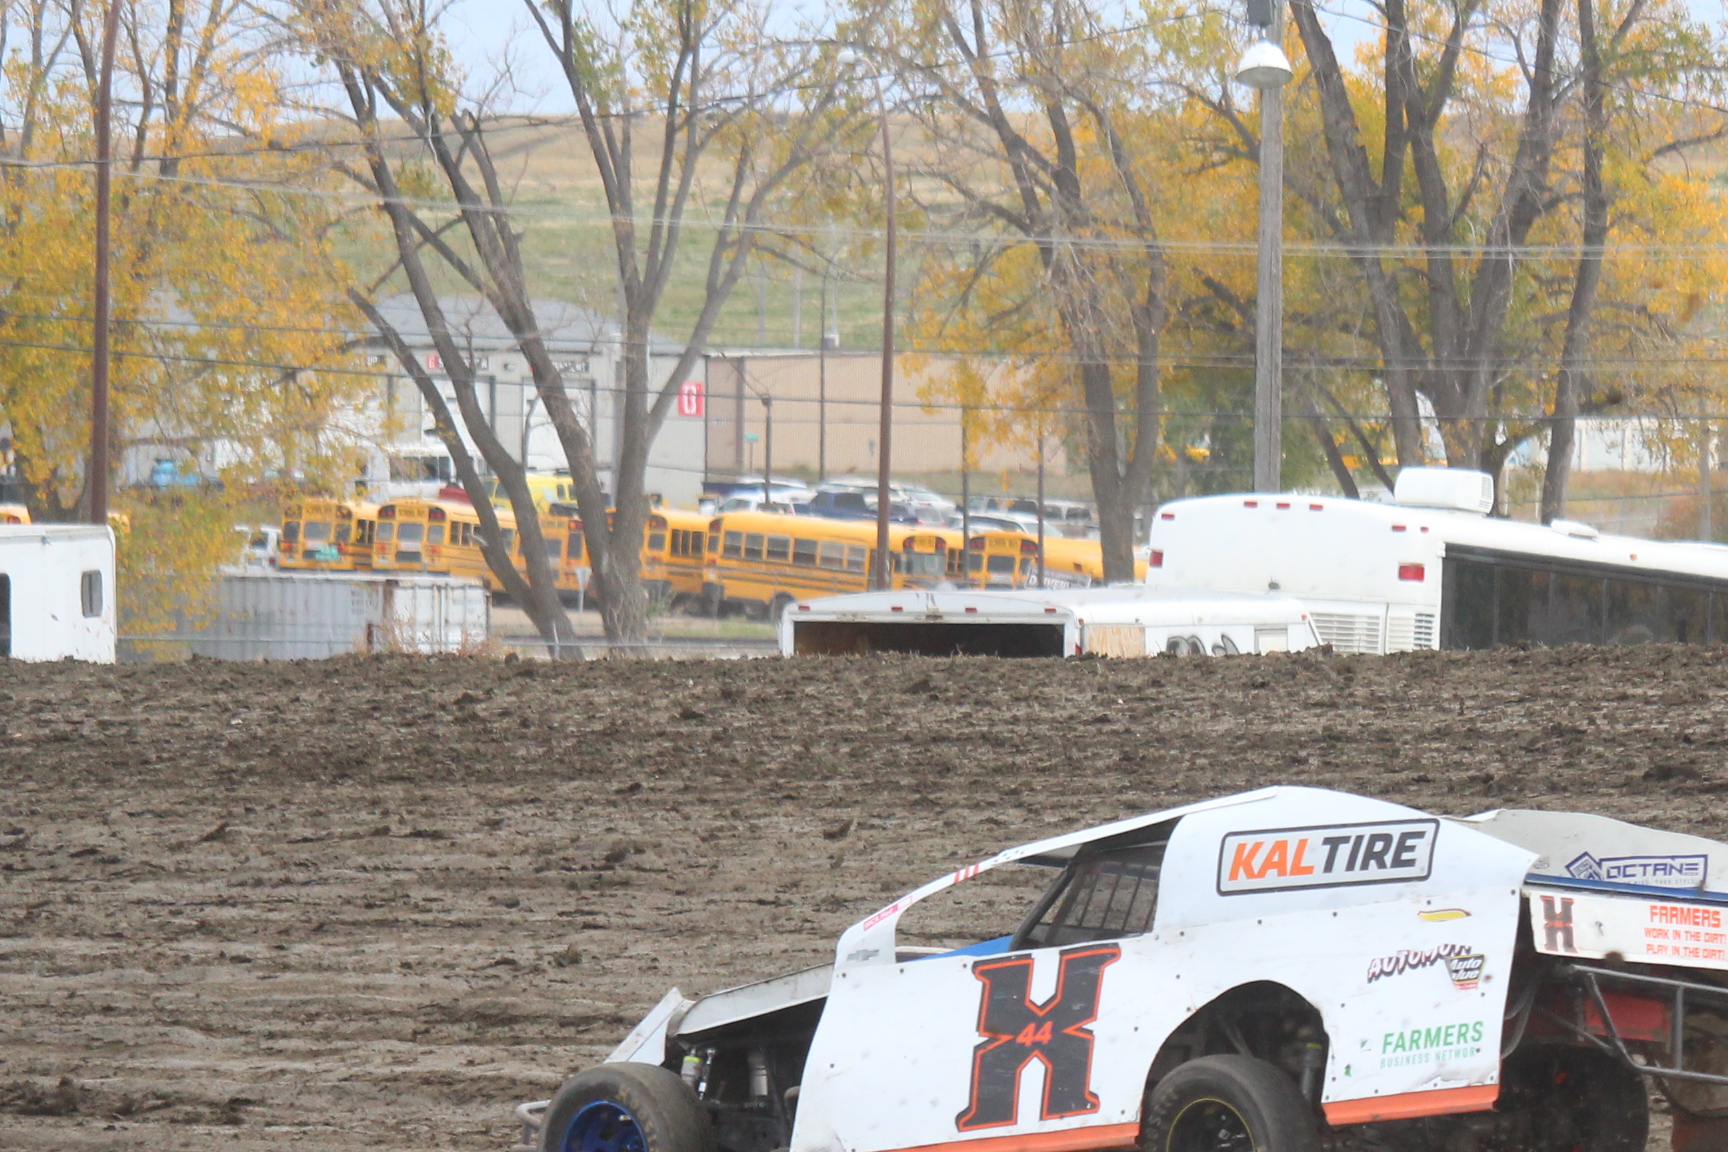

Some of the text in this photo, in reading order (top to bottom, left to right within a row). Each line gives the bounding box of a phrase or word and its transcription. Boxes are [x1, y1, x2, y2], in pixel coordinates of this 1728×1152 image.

[1228, 831, 1427, 881] KAL TIRE
[1606, 862, 1700, 879] OCTANE
[1650, 905, 1721, 928] FARMERS
[1644, 927, 1727, 945] WORK IN THE DIRT!
[1646, 943, 1725, 960] PLAY IN THE DIRT!
[1015, 1020, 1054, 1047] 44
[1382, 1020, 1484, 1055] FARMERS
[1380, 1046, 1481, 1069] BUSINESS NETWOR
